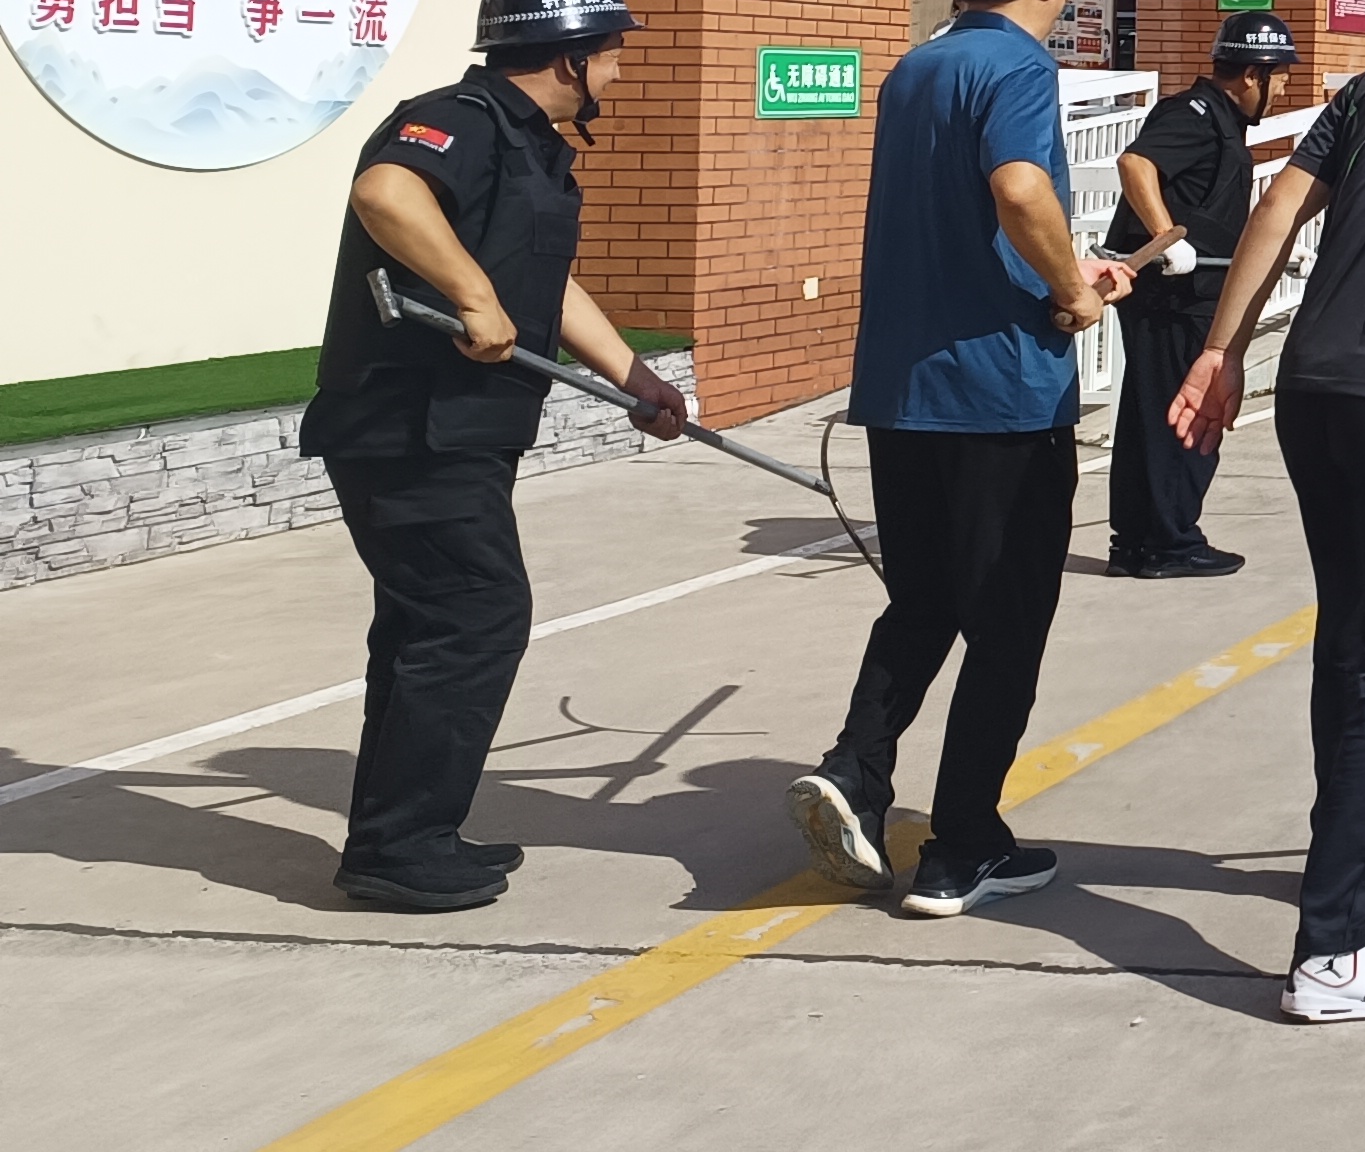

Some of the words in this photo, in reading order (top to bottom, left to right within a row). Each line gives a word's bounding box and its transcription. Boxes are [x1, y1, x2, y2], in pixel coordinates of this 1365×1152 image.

[787, 63, 855, 88] 无障碍通道
